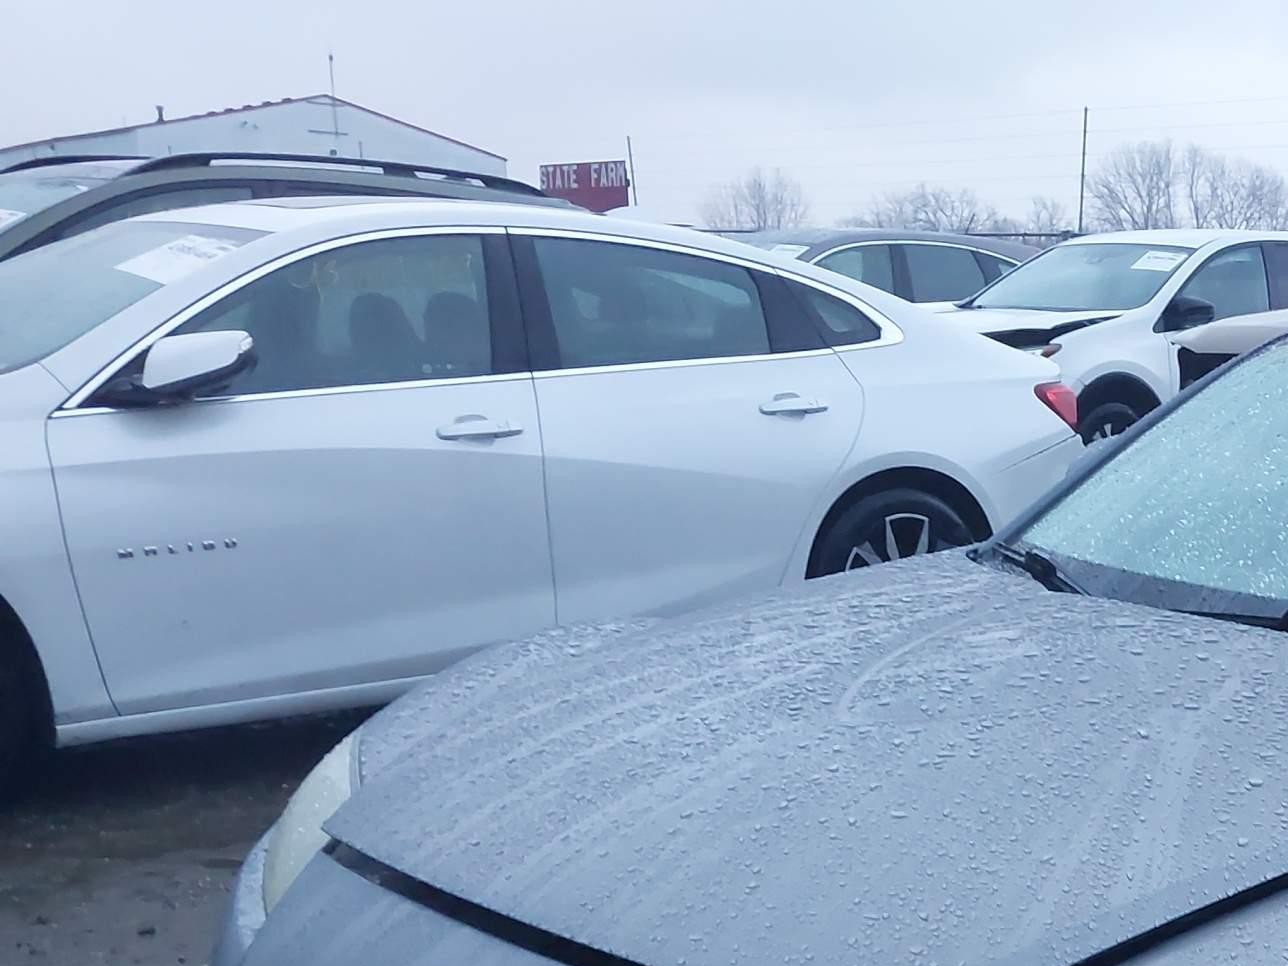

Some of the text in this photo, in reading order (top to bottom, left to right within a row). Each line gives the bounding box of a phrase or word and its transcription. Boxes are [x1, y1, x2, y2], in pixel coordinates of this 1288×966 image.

[540, 162, 626, 189] STATE FARM
[116, 538, 238, 559] MALIBU
